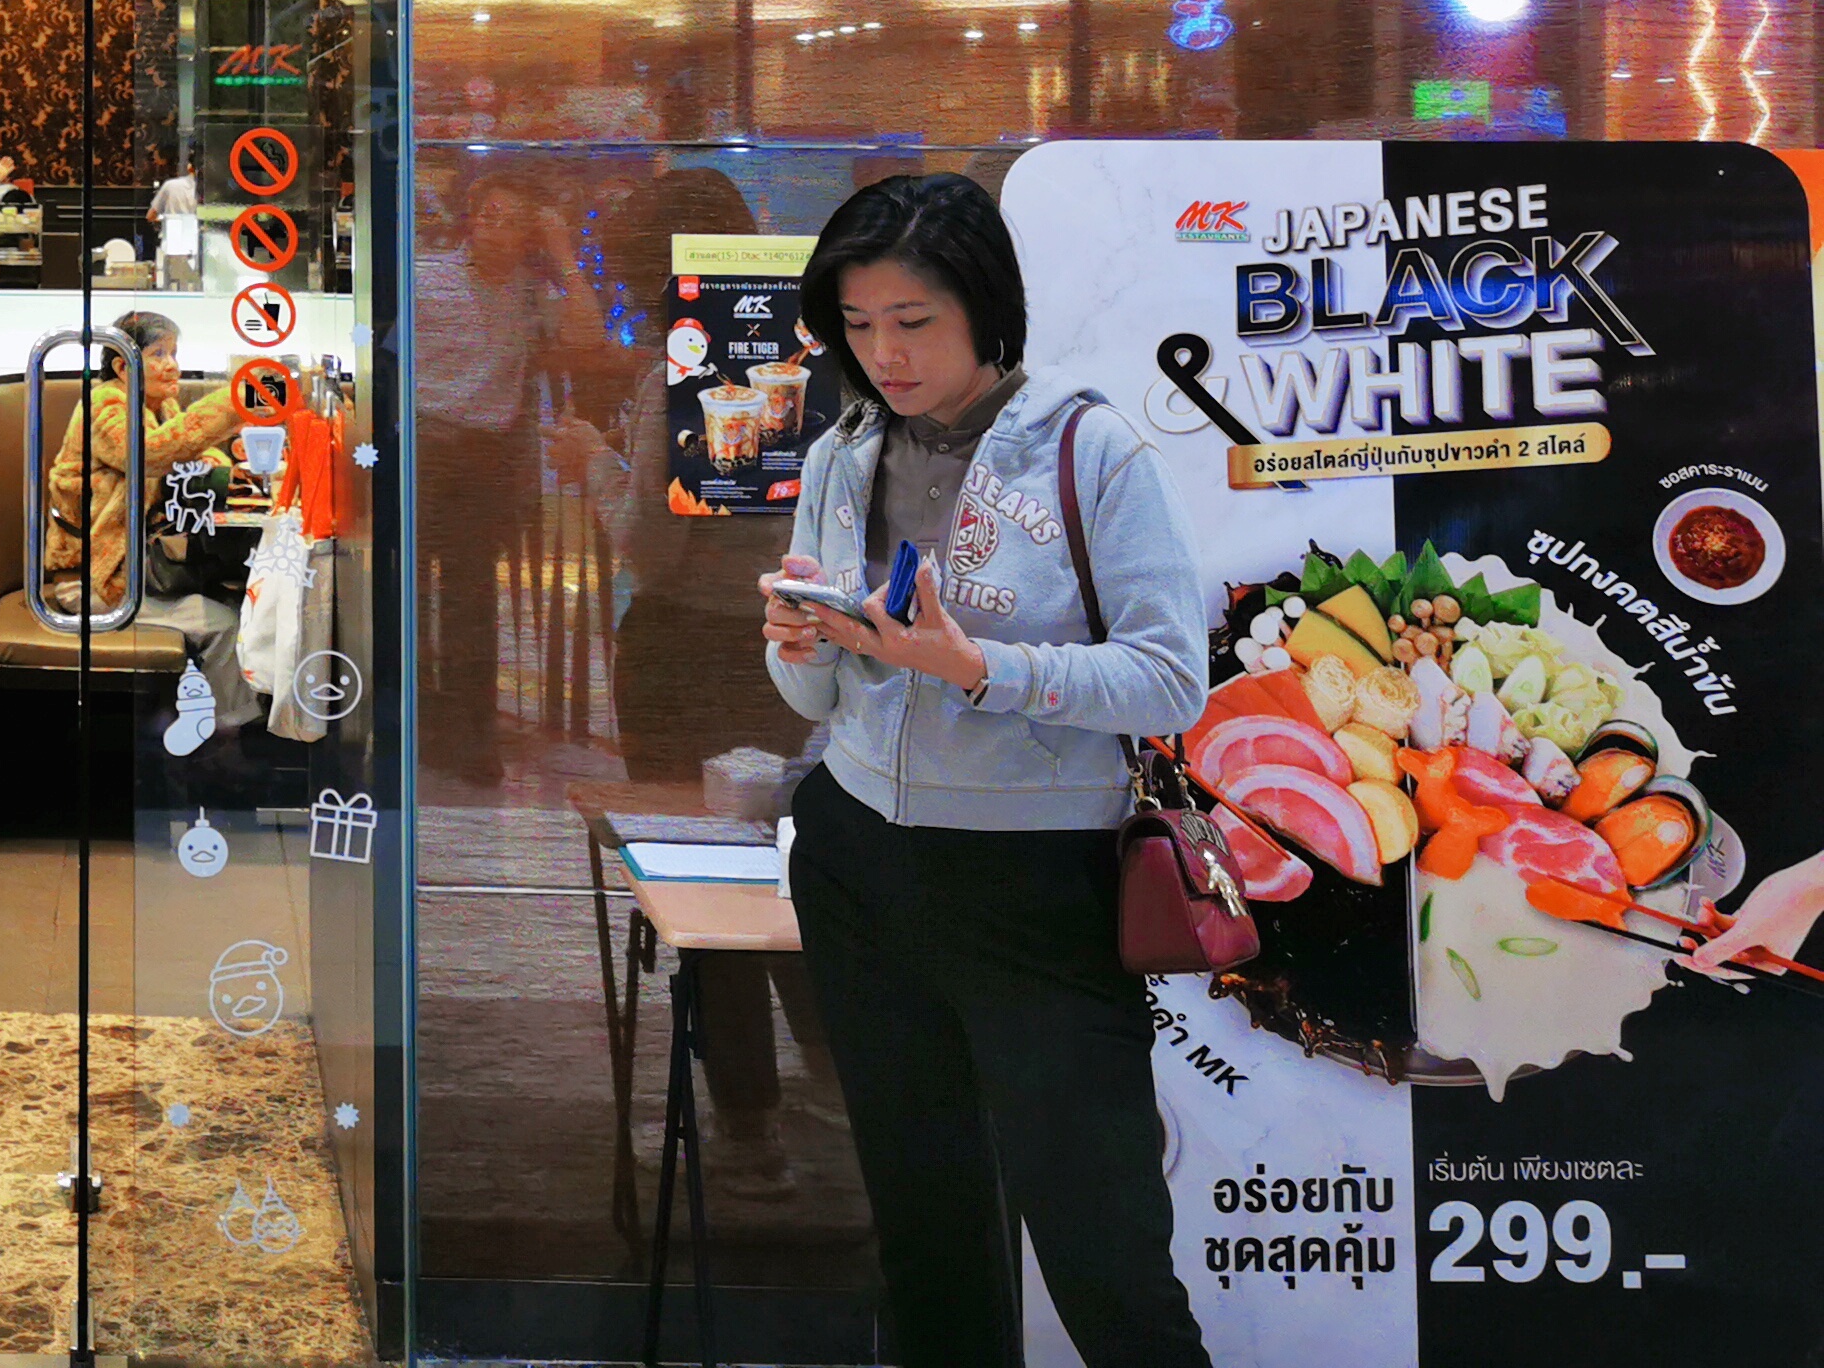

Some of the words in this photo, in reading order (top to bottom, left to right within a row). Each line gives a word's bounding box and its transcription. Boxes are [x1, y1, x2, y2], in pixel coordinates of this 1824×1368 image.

[217, 43, 303, 75] MK
[1175, 200, 1249, 231] MK
[1262, 184, 1550, 255] JAPANESE
[733, 295, 772, 313] MK
[1234, 230, 1656, 355] BLACK
[728, 341, 749, 355] FIRE
[751, 341, 779, 355] TIGER
[1143, 331, 1286, 464] &
[1238, 327, 1609, 438] WHITE
[1253, 434, 1511, 473] อร่อยสไตล์ญี่ปุ่นกับซุปขาวดำ
[1517, 439, 1531, 458] 2
[1537, 433, 1587, 457] สไตล์
[965, 463, 1062, 545] JEANS
[1185, 1044, 1250, 1097] MK
[1212, 1162, 1395, 1214] อร่อยกับ
[1428, 1150, 1504, 1183] เริ่มต้น
[1513, 1153, 1645, 1182] เพียงเซตละ
[1204, 1223, 1396, 1290] ชุดสุดคุ้ม
[1428, 1199, 1687, 1289] 299.-
